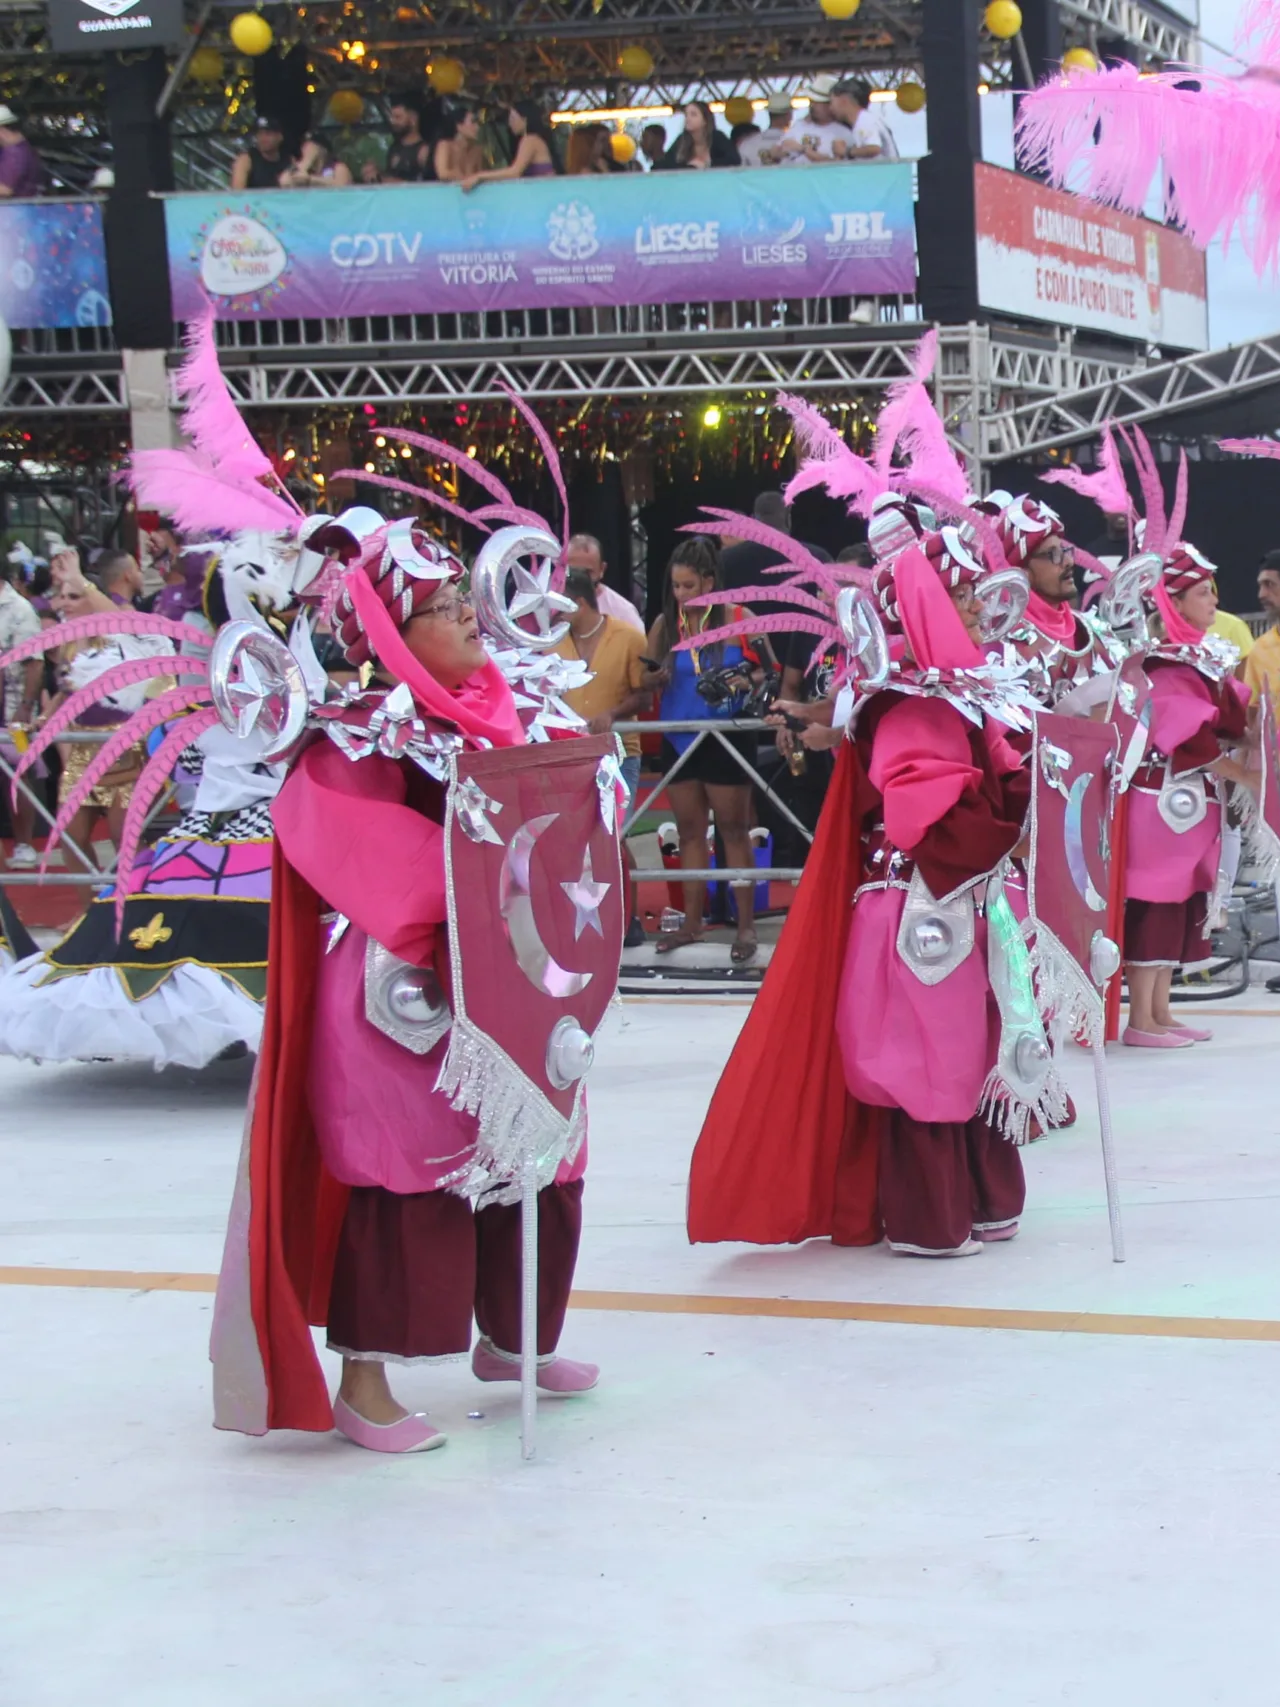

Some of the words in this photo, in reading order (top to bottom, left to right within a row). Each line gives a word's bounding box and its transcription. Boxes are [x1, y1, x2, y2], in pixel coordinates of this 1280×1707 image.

[78, 16, 151, 32] GUARAPARI
[635, 221, 719, 254] LIESGE
[825, 212, 892, 242] JBL
[1034, 206, 1085, 251] CARNAVAL
[1087, 222, 1101, 255] DE
[331, 232, 422, 266] CDTV
[742, 244, 807, 264] LIESES
[1036, 267, 1042, 299] E
[1045, 270, 1068, 305] COM
[1071, 275, 1078, 306] A
[1079, 277, 1106, 312] PURO
